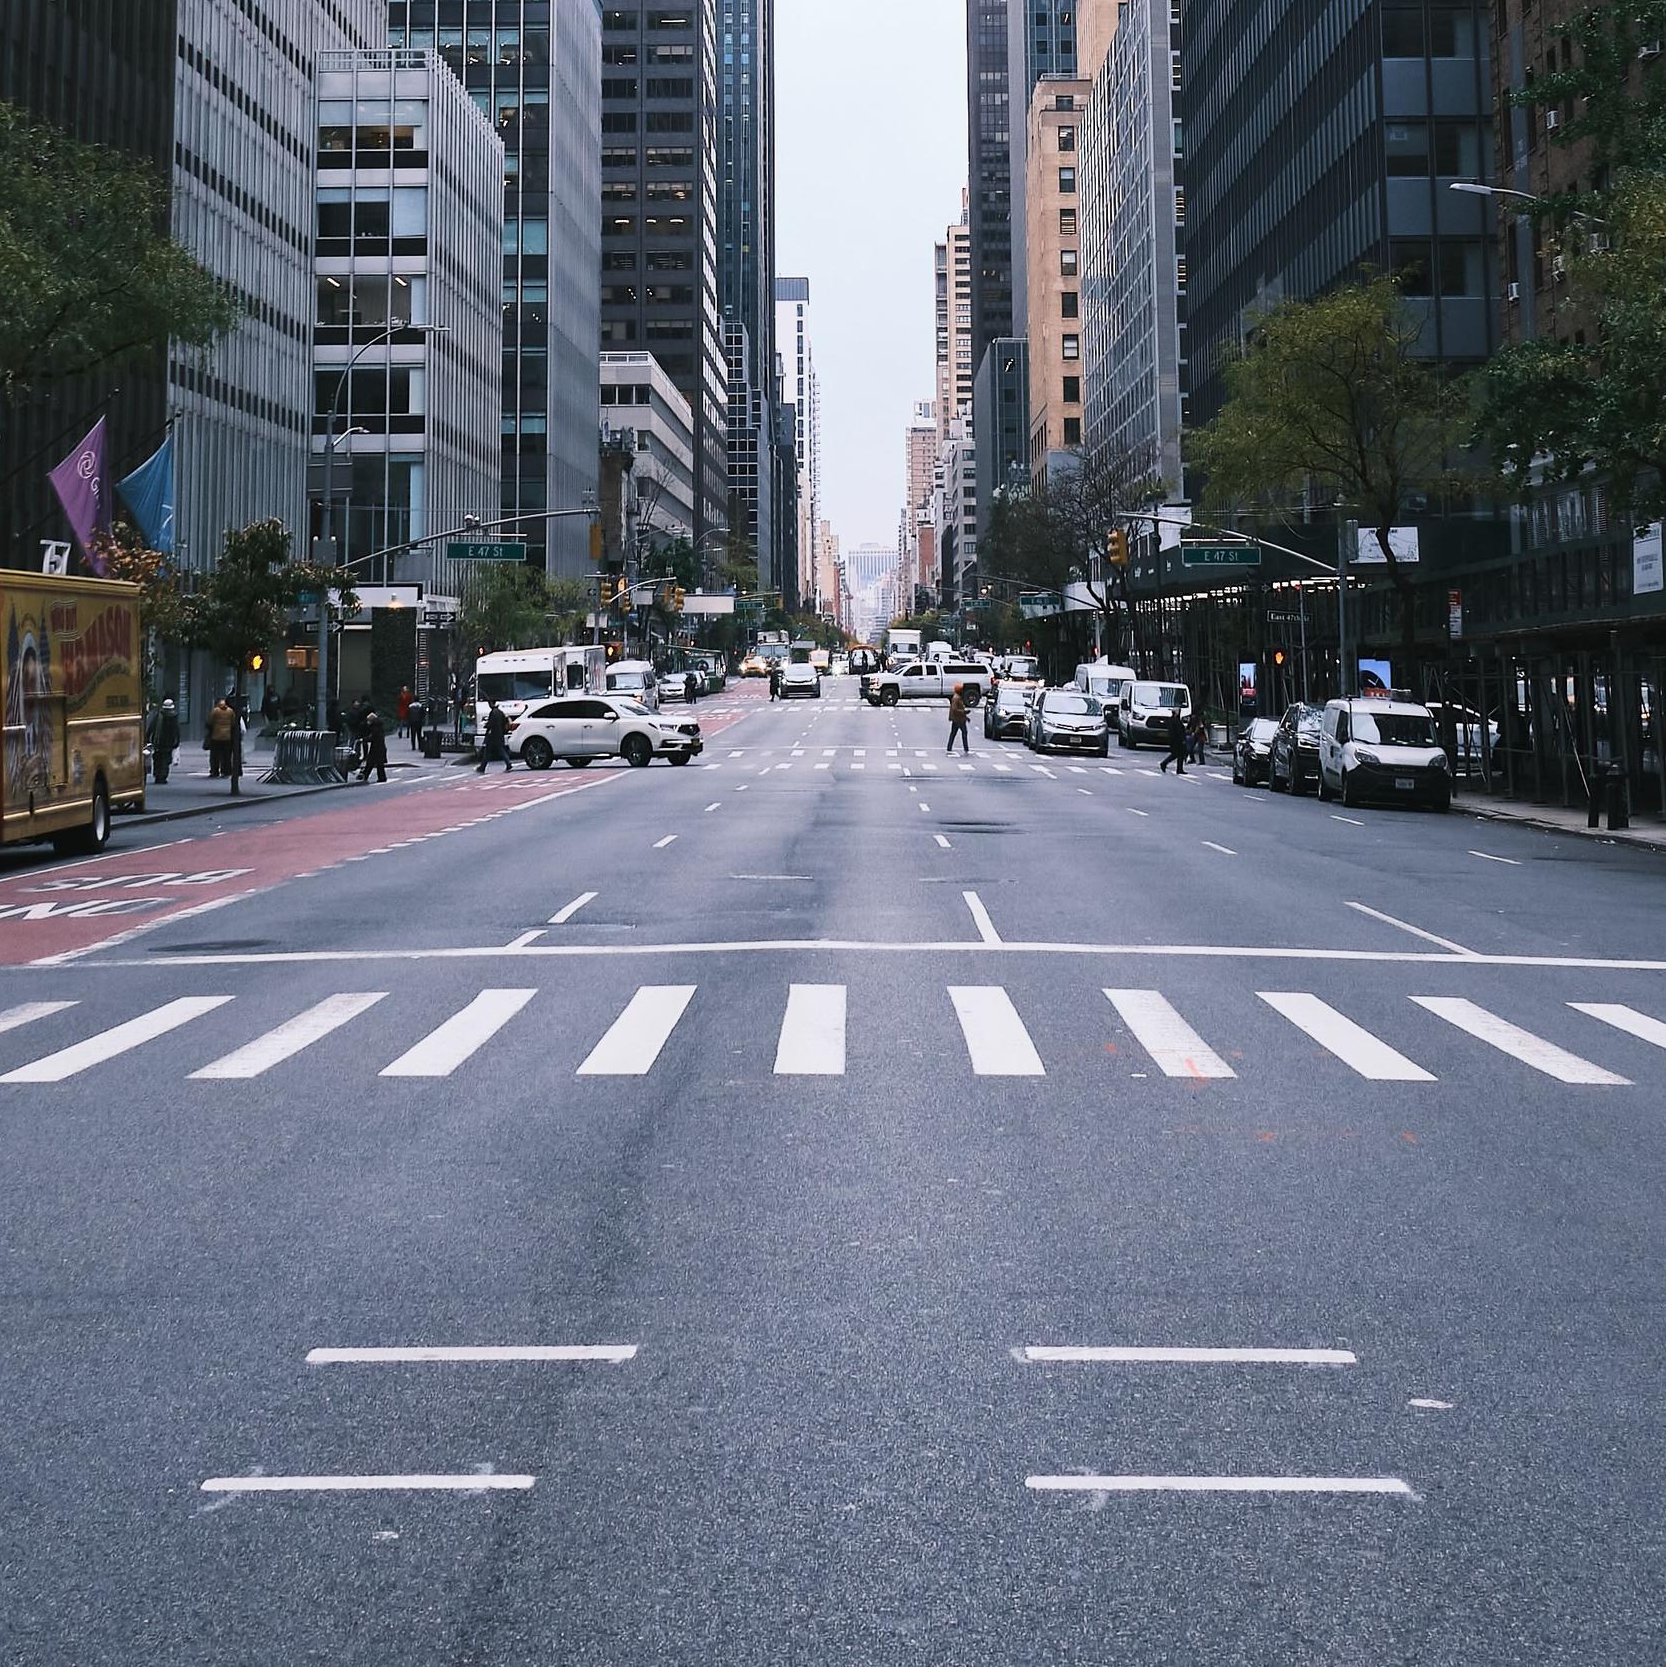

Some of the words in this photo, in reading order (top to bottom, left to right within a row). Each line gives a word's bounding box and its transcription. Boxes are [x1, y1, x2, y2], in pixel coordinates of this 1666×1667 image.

[469, 546, 475, 556] E
[478, 546, 490, 556] 47
[1204, 551, 1211, 562] E
[1213, 551, 1226, 562] 47
[17, 867, 255, 893] BUS
